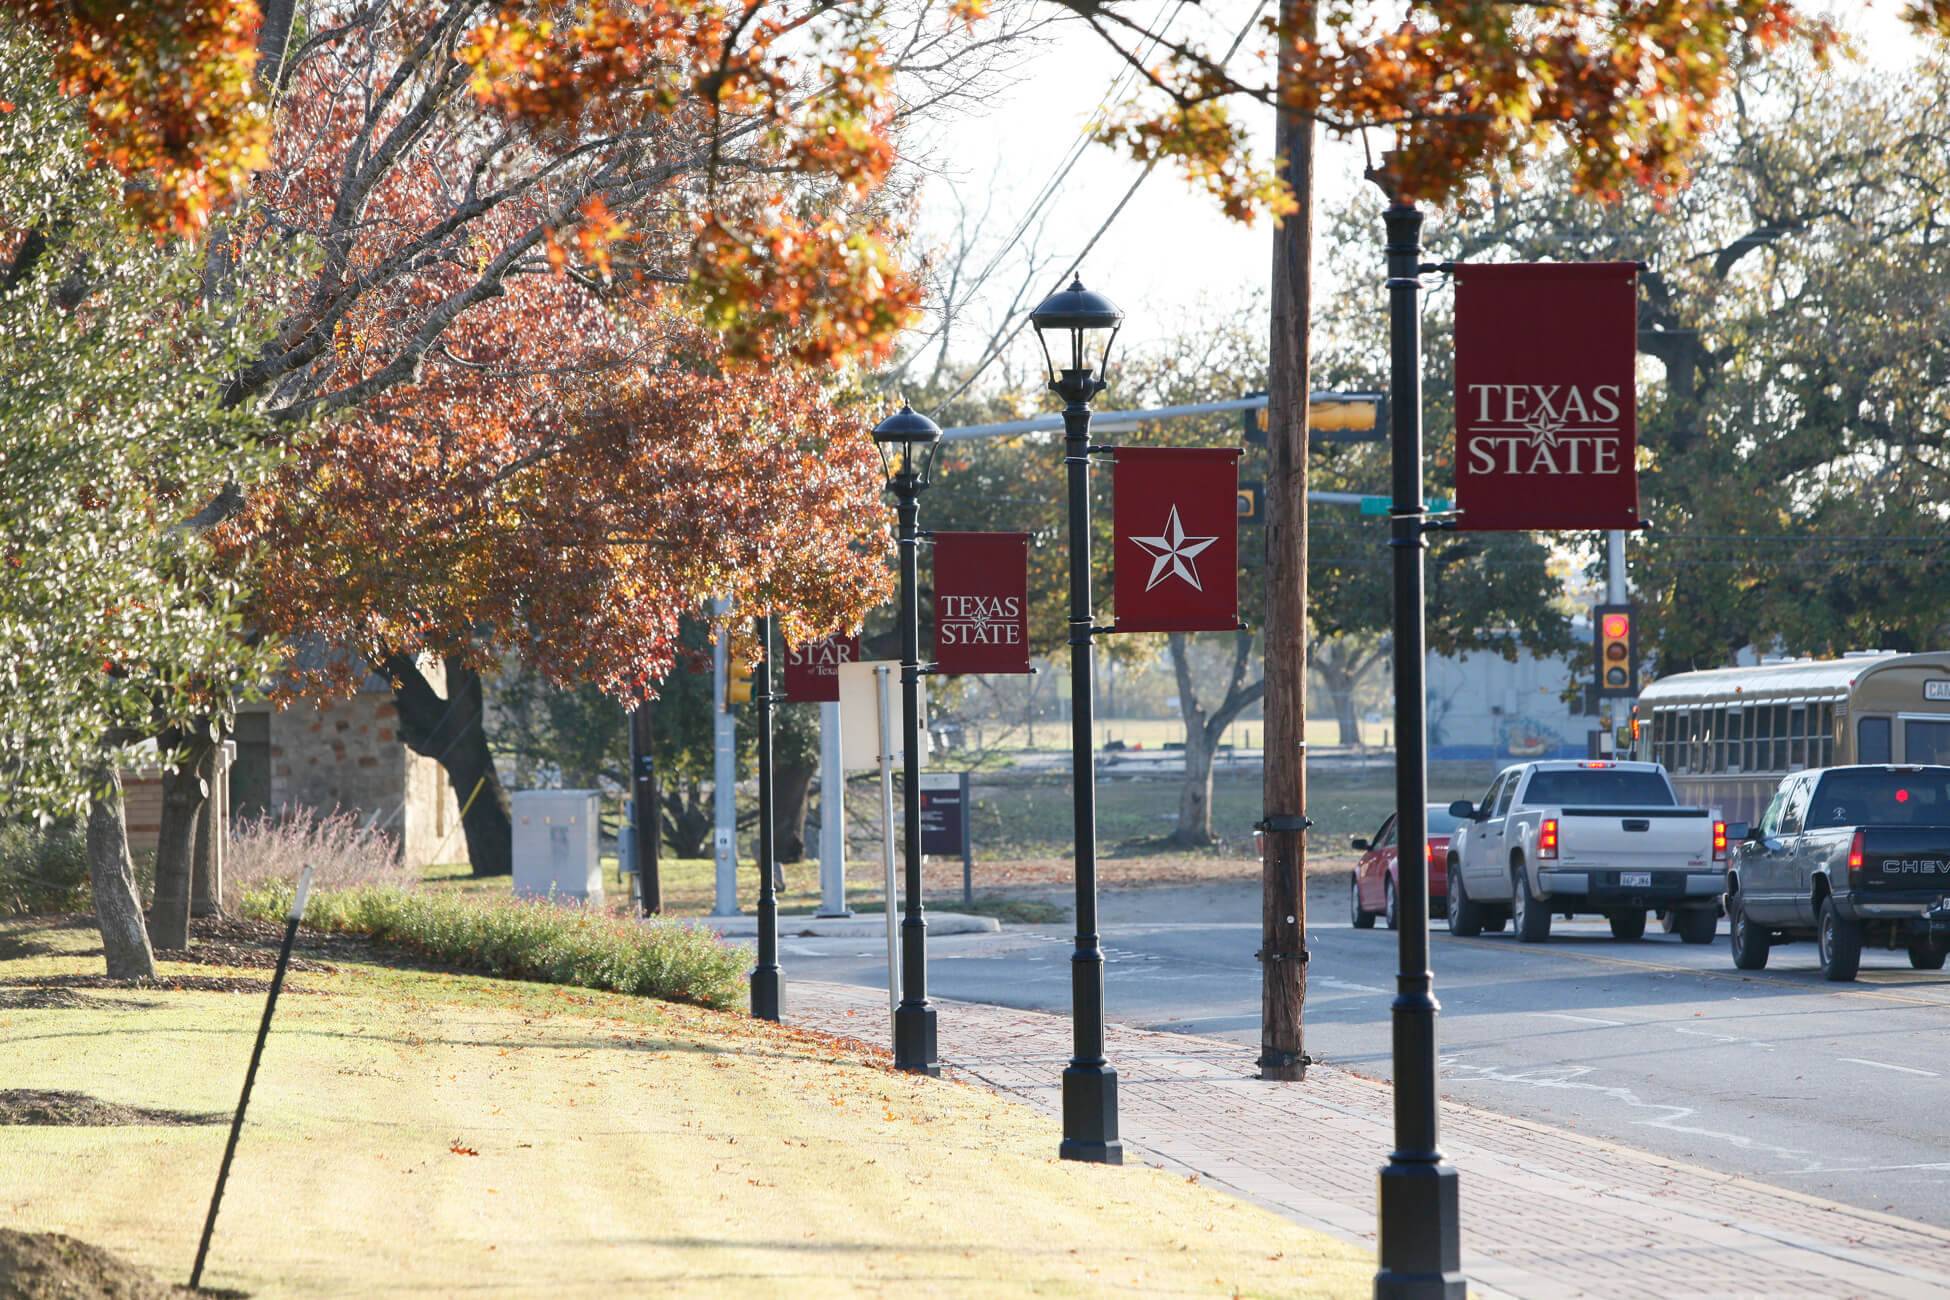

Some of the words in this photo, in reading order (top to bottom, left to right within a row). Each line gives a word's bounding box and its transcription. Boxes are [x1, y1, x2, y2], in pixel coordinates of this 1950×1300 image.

[1468, 384, 1620, 423] TEXAS
[1468, 436, 1621, 475] STATE
[941, 595, 1019, 617] TEXAS
[941, 623, 1020, 645] STATE
[789, 644, 852, 665] STAR
[816, 666, 838, 675] Texa
[1883, 859, 1950, 874] CHEV
